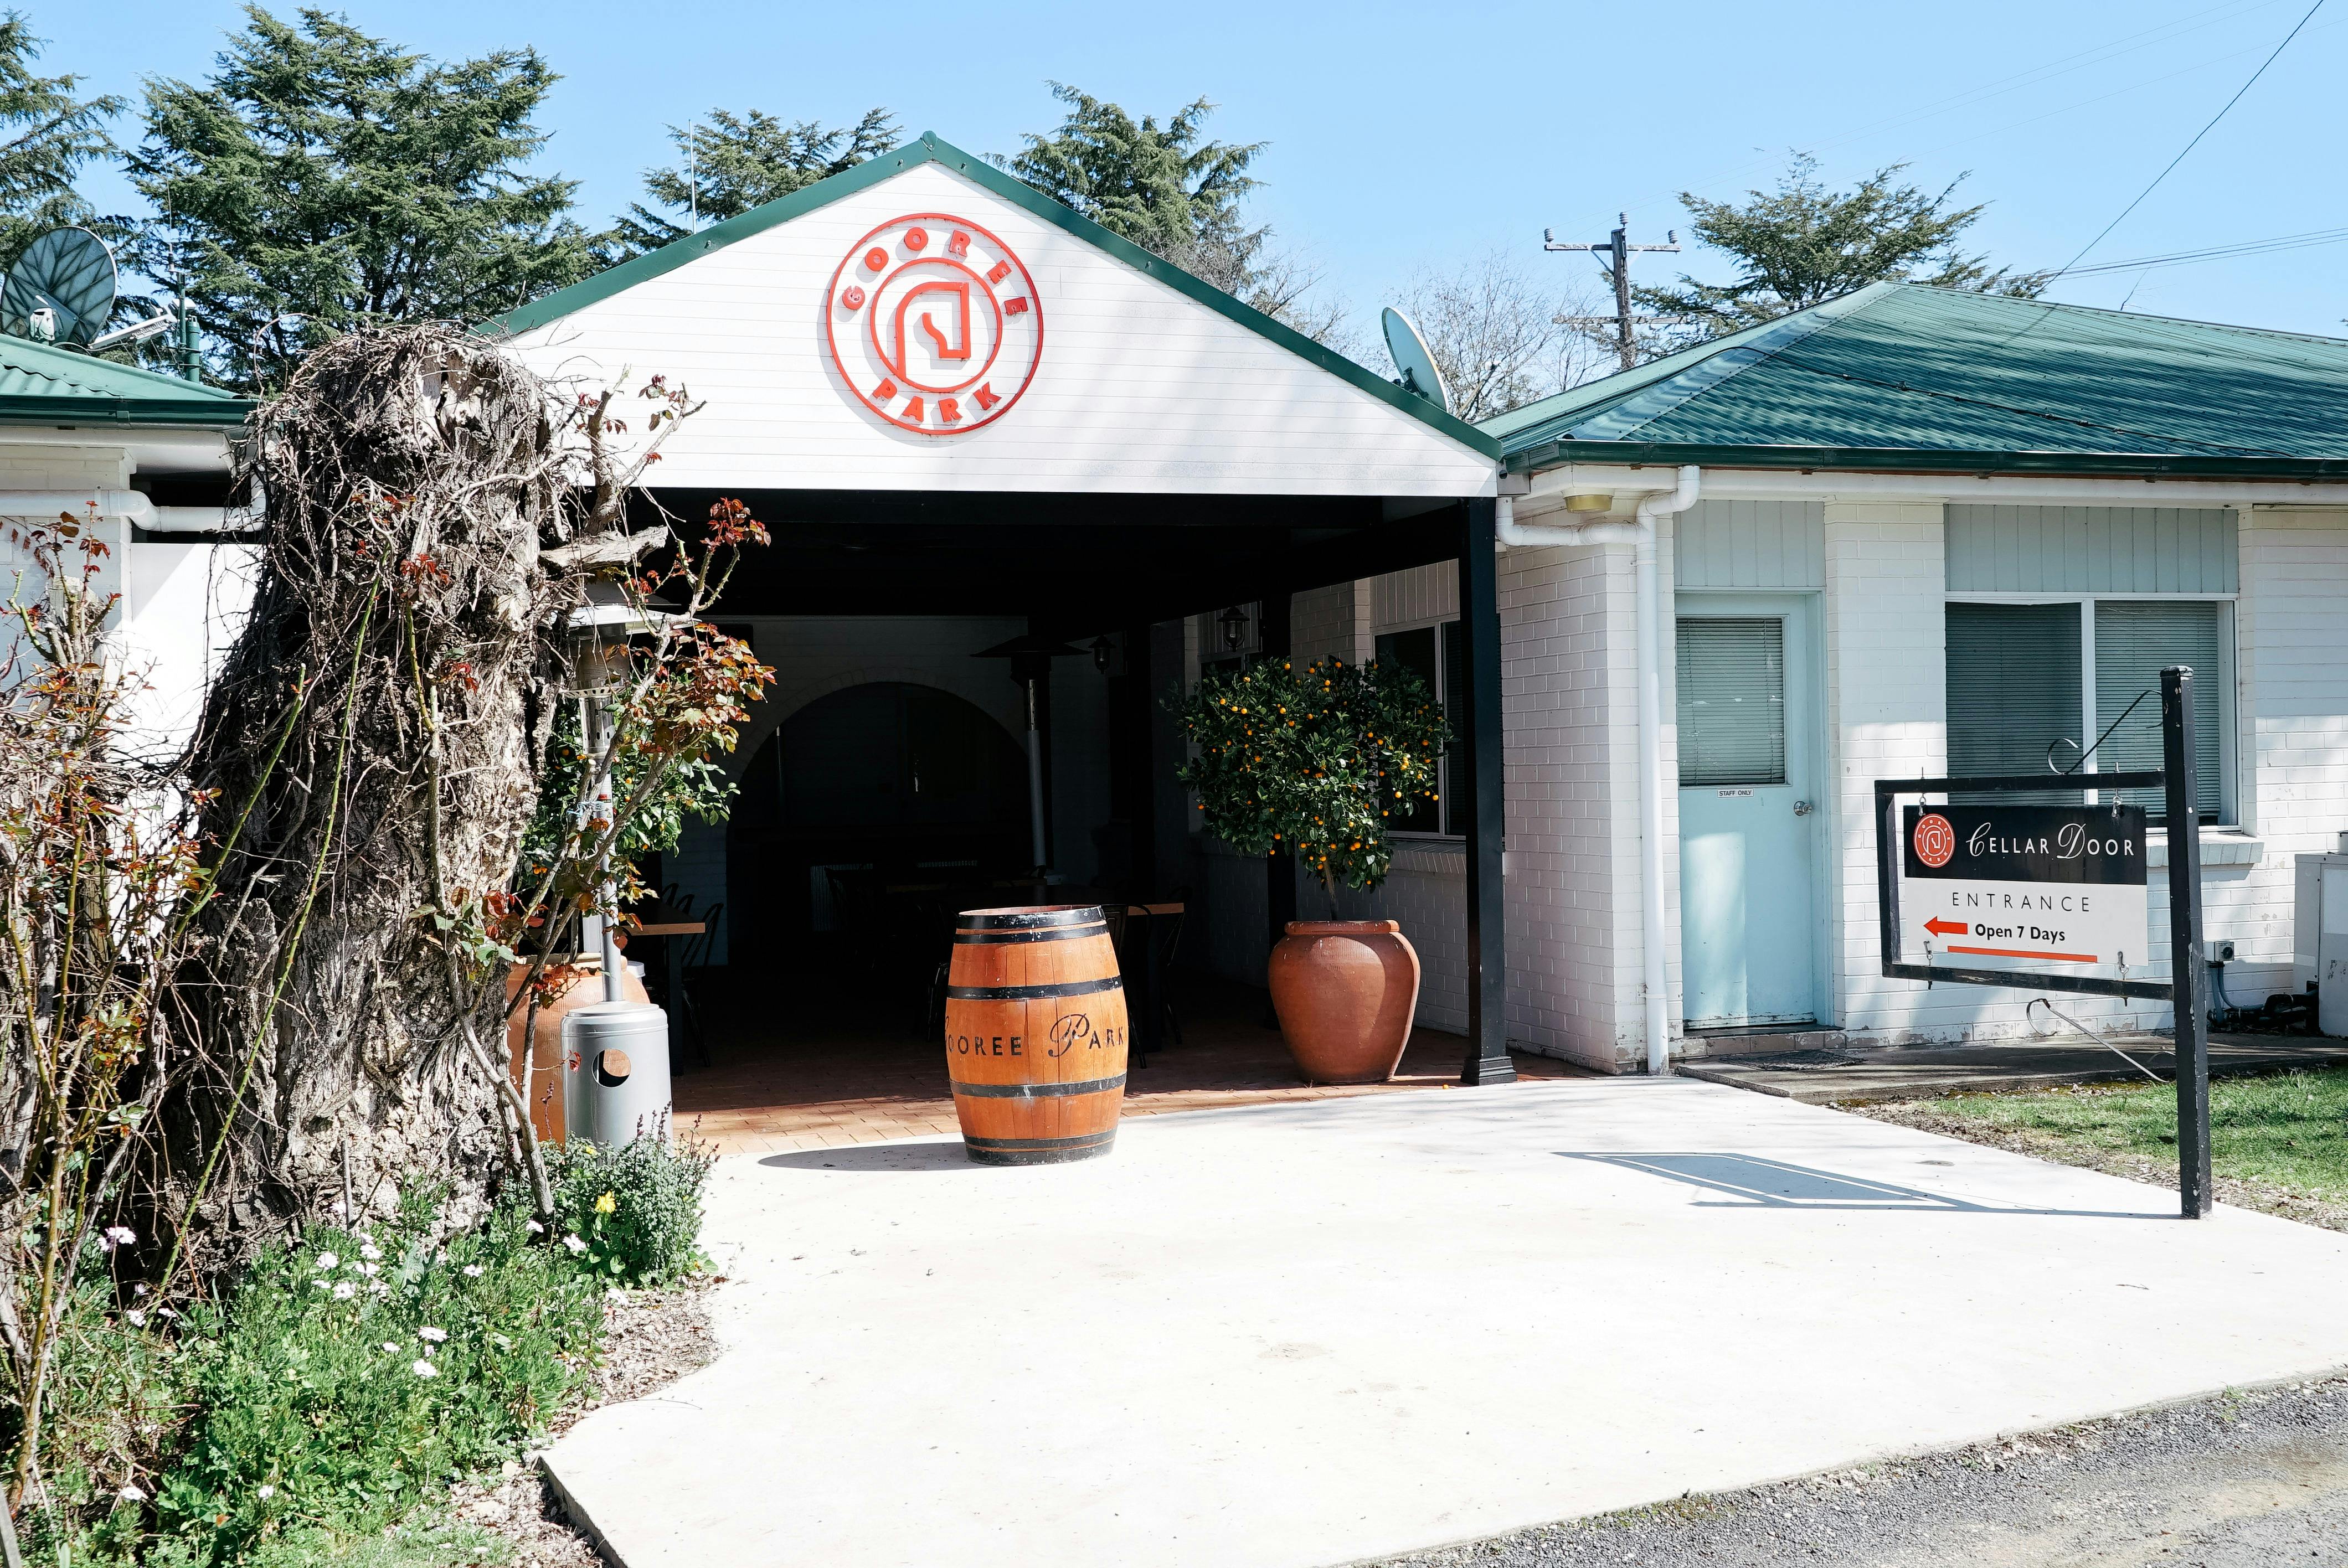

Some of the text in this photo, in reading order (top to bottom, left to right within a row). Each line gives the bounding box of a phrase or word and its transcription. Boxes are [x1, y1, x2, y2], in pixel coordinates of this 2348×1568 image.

[842, 226, 1029, 316] GOOREE
[872, 377, 1002, 422] PARK
[1952, 892, 2089, 912] ENTRANCE
[1975, 923, 2066, 945] Open 7 Days
[945, 1013, 1124, 1058] OOREE PARK
